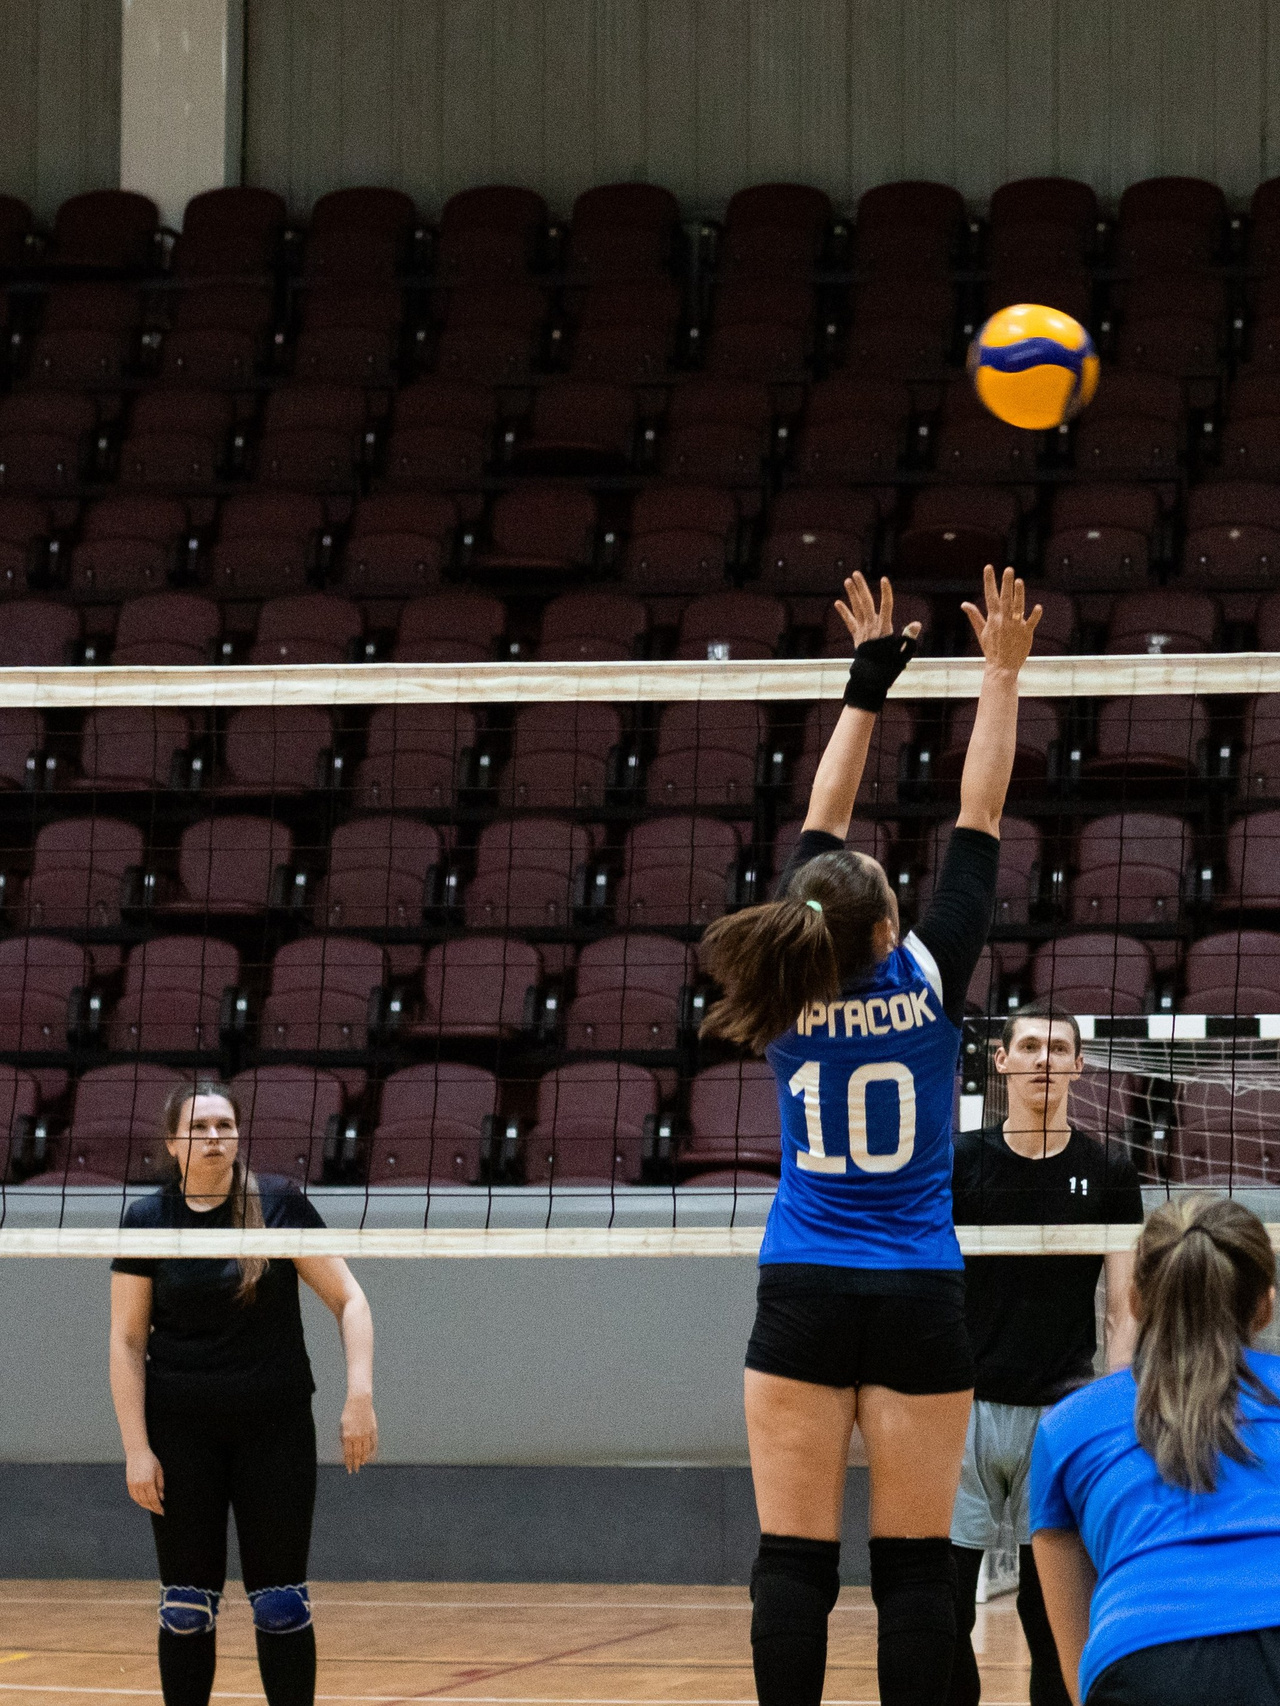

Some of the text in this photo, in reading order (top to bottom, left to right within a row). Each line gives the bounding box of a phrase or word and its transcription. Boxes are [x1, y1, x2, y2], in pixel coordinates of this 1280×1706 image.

[796, 987, 937, 1038] РГАСОК
[788, 1060, 916, 1174] 10
[1069, 1176, 1088, 1196] 11
